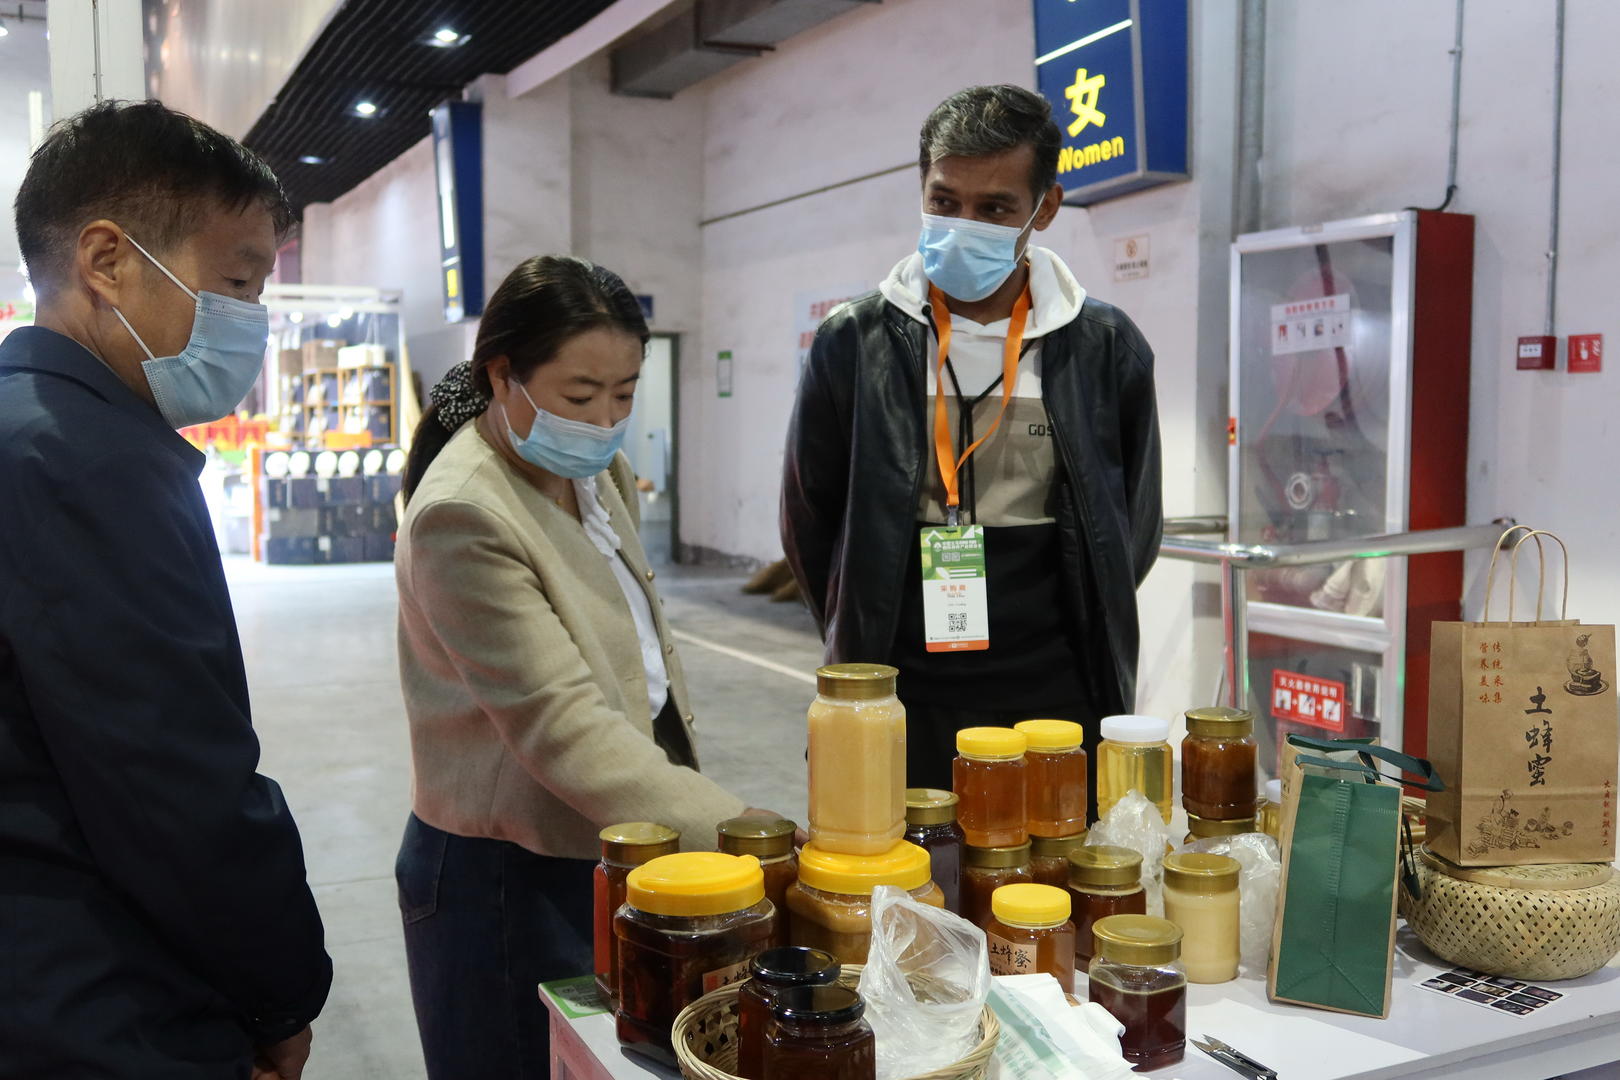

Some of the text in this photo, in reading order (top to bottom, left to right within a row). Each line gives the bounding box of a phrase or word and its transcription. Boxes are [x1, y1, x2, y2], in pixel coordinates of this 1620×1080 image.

[1065, 68, 1106, 138] 女
[1057, 136, 1125, 174] Women
[1479, 641, 1490, 705] 营养美味
[1492, 641, 1504, 705] 传统采集
[1524, 686, 1553, 787] 土蜂蜜
[990, 942, 1032, 968] 土蜂蜜
